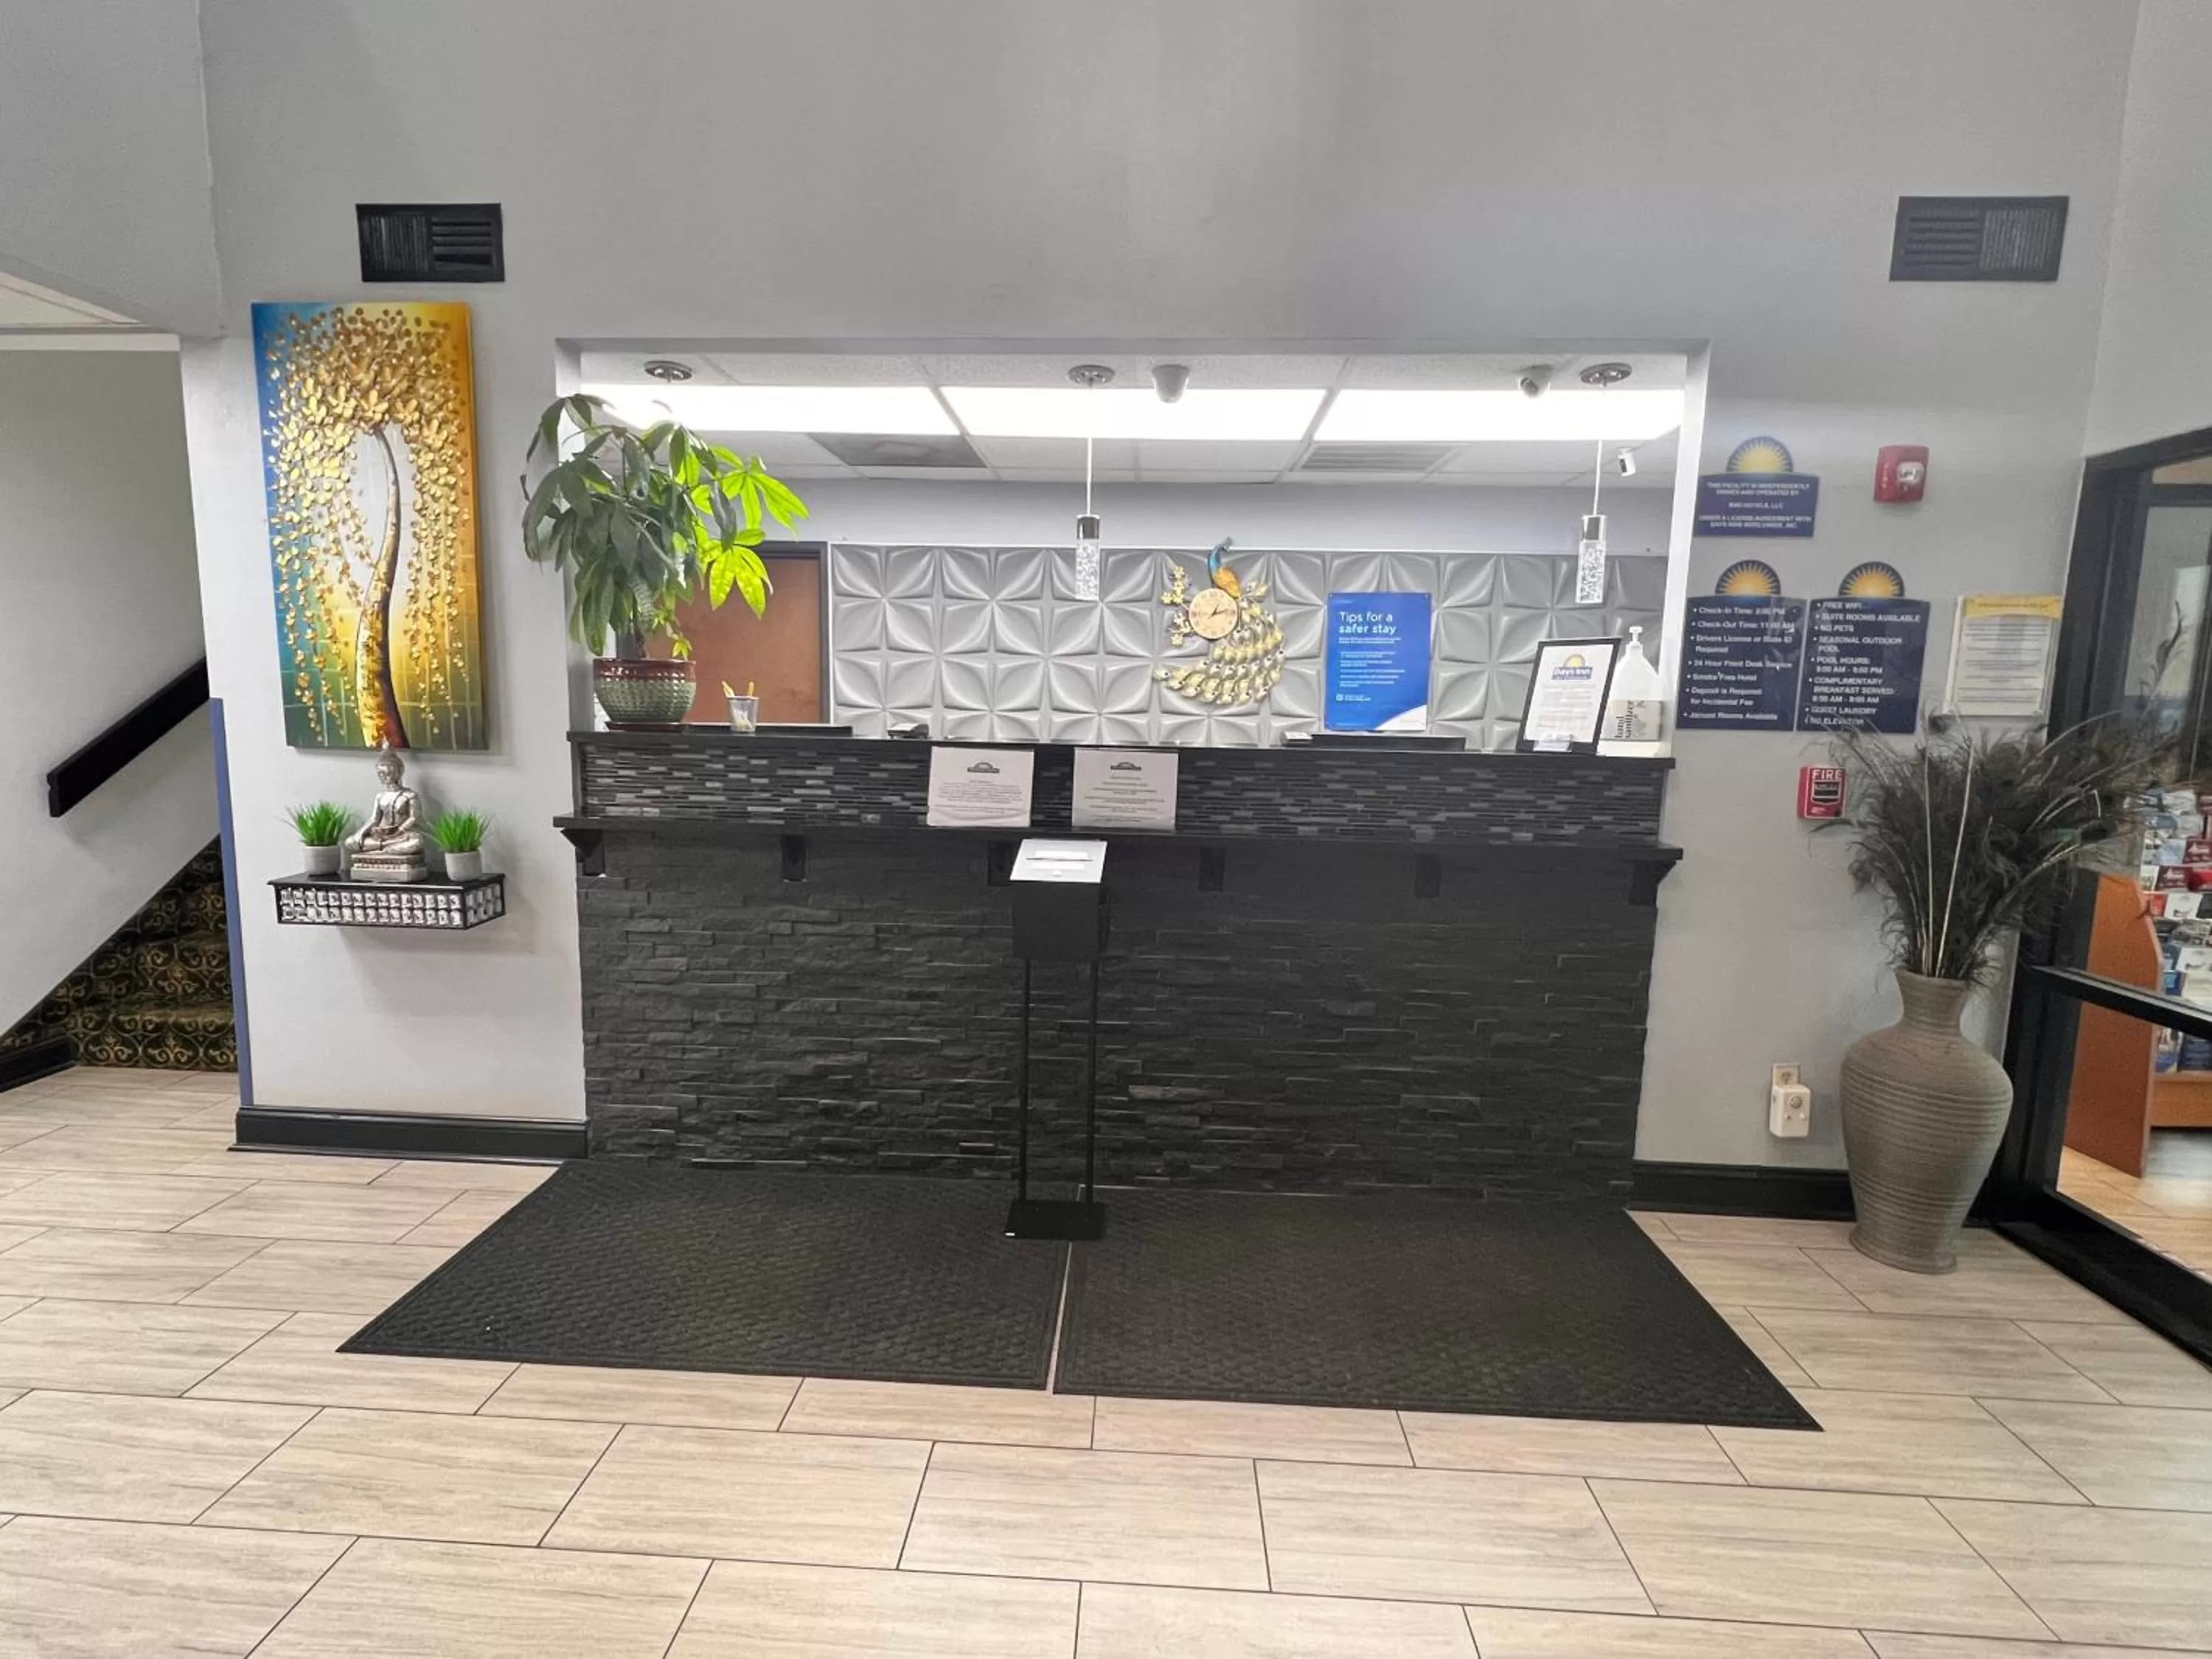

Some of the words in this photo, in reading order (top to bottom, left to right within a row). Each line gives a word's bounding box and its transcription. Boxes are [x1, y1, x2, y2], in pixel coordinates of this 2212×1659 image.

[1339, 611, 1363, 623] Tips
[1366, 611, 1382, 622] for
[1386, 613, 1393, 622] a
[1877, 614, 1921, 622] AVAILABLE
[1339, 624, 1369, 633] safer
[1371, 624, 1396, 635] stay
[1819, 636, 1860, 644] SEASONAL
[1839, 707, 1877, 715] LAUNDRY
[1613, 715, 1624, 738] hand
[1812, 769, 1843, 779] FIRE
